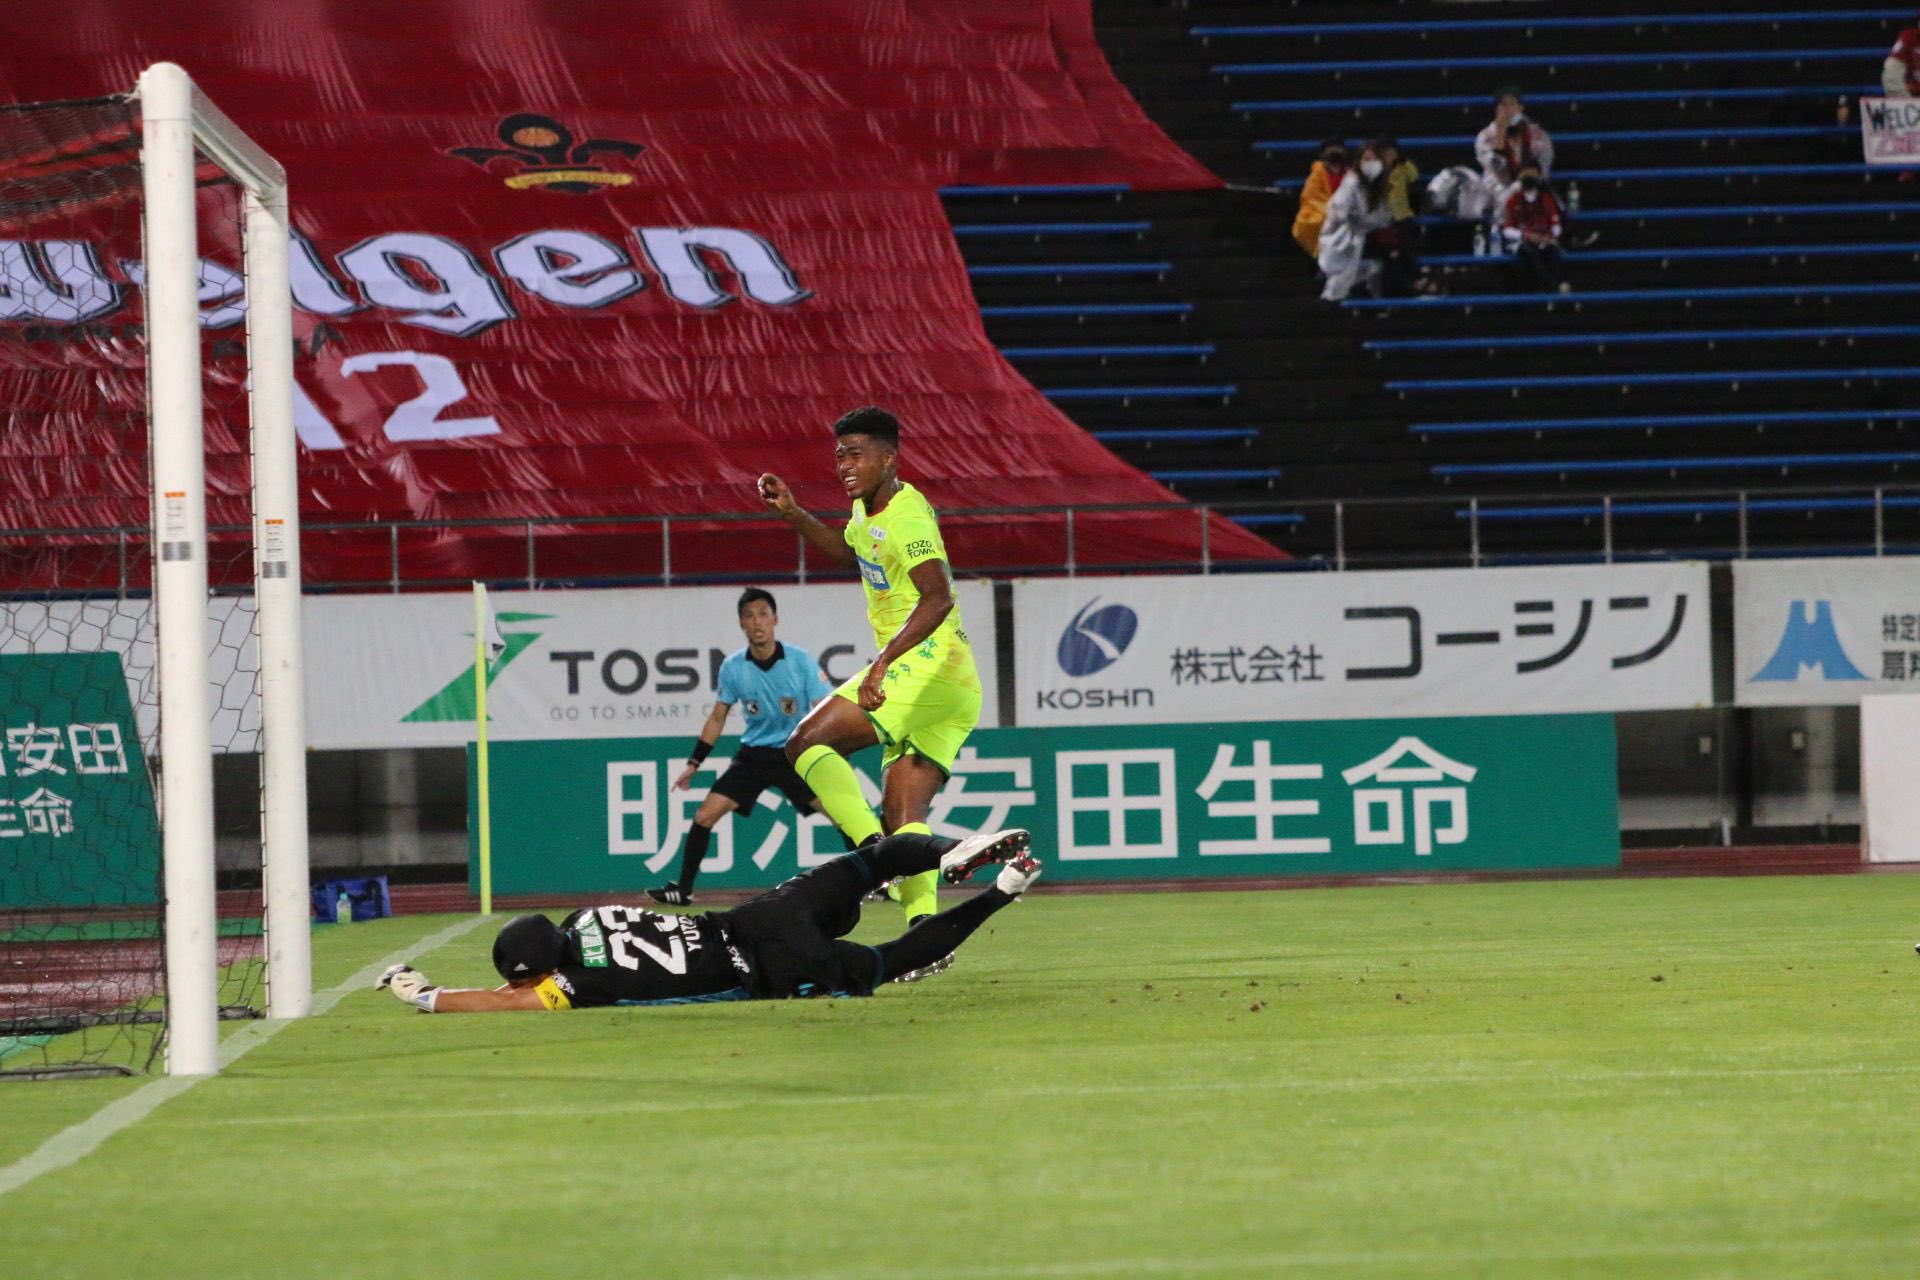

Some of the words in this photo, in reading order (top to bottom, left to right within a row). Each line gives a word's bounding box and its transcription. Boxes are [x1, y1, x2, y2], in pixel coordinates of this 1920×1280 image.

[1171, 644, 1325, 685] 株式会社
[1344, 594, 1688, 680] コーシン
[551, 707, 578, 721] GO
[592, 706, 616, 719] TO
[625, 704, 690, 719] SMART
[0, 722, 128, 777] 安田
